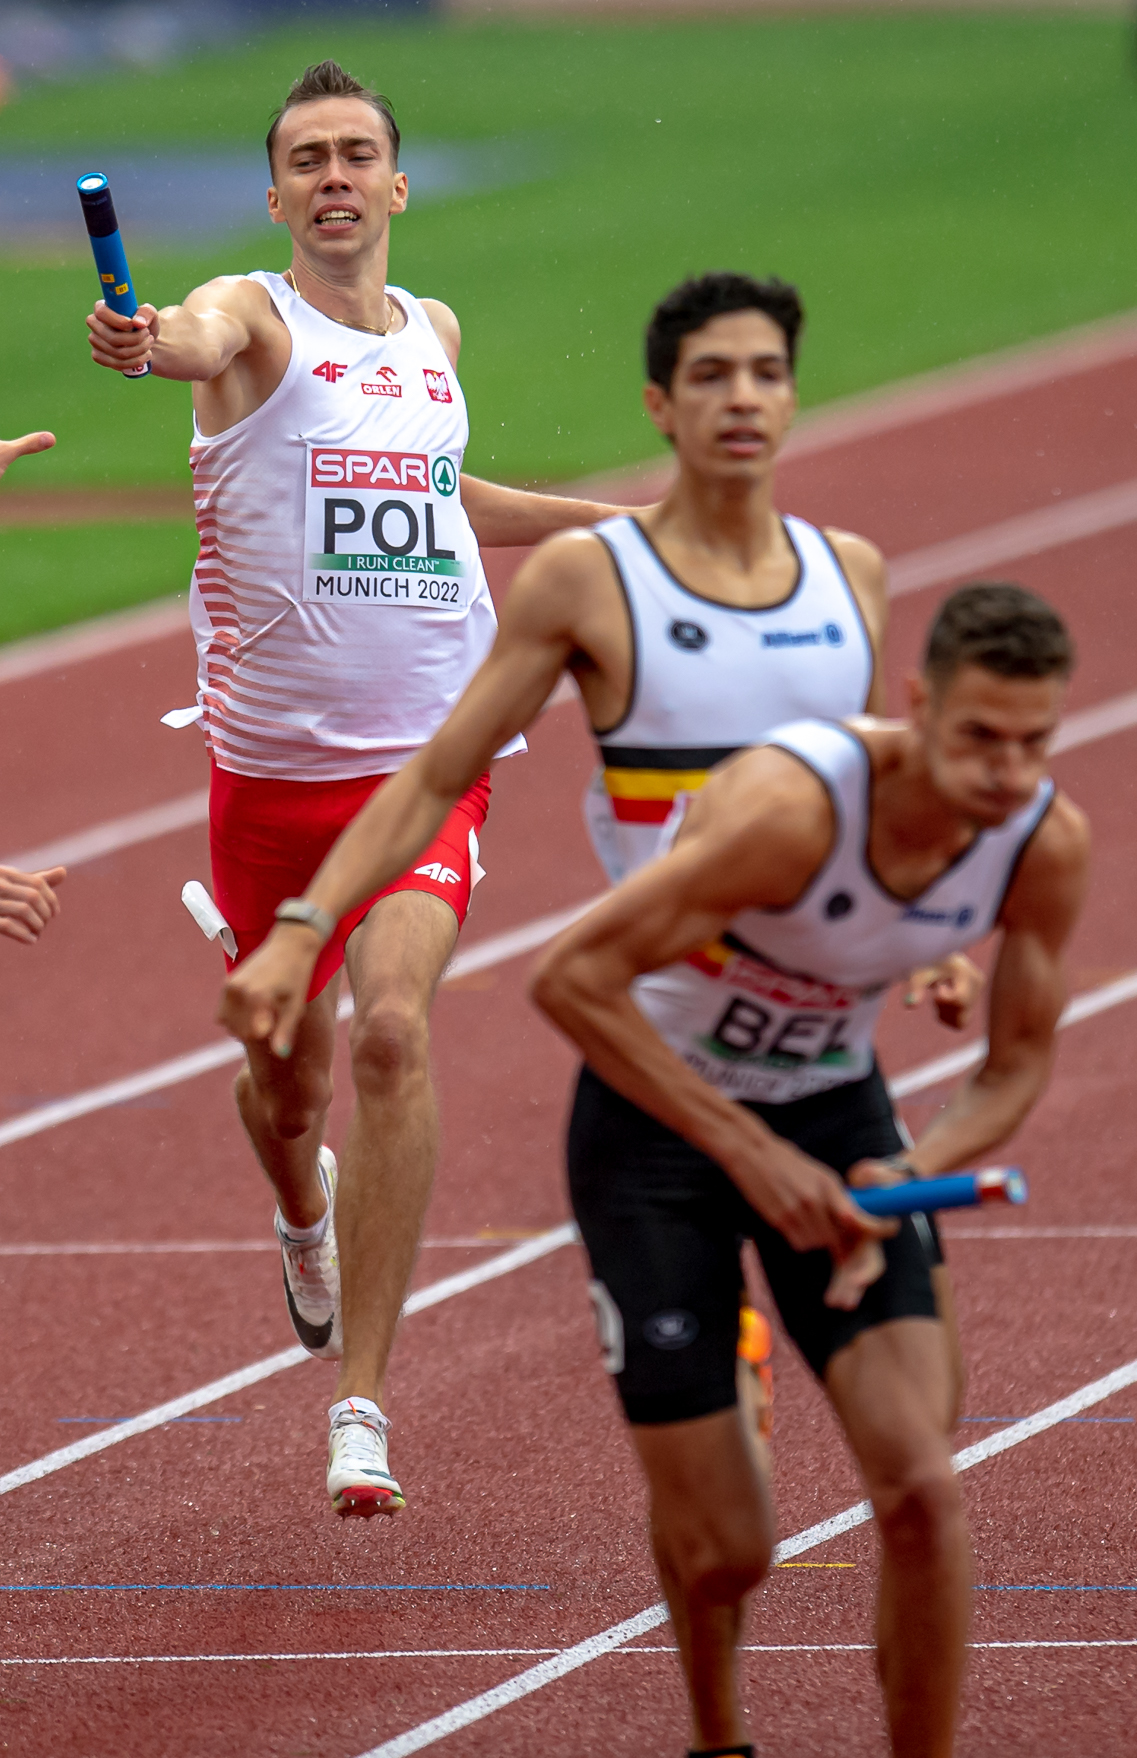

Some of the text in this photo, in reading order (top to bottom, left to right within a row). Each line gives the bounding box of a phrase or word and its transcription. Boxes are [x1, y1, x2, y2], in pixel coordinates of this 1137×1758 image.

[312, 361, 348, 383] 4F
[363, 384, 401, 396] ORLEN
[315, 454, 427, 487] SPAR
[324, 498, 455, 560] POL
[348, 556, 352, 569] I
[356, 556, 389, 570] RUN
[316, 576, 460, 603] MUNICH 2022
[414, 862, 461, 884] 4F
[714, 996, 849, 1062] BEL
